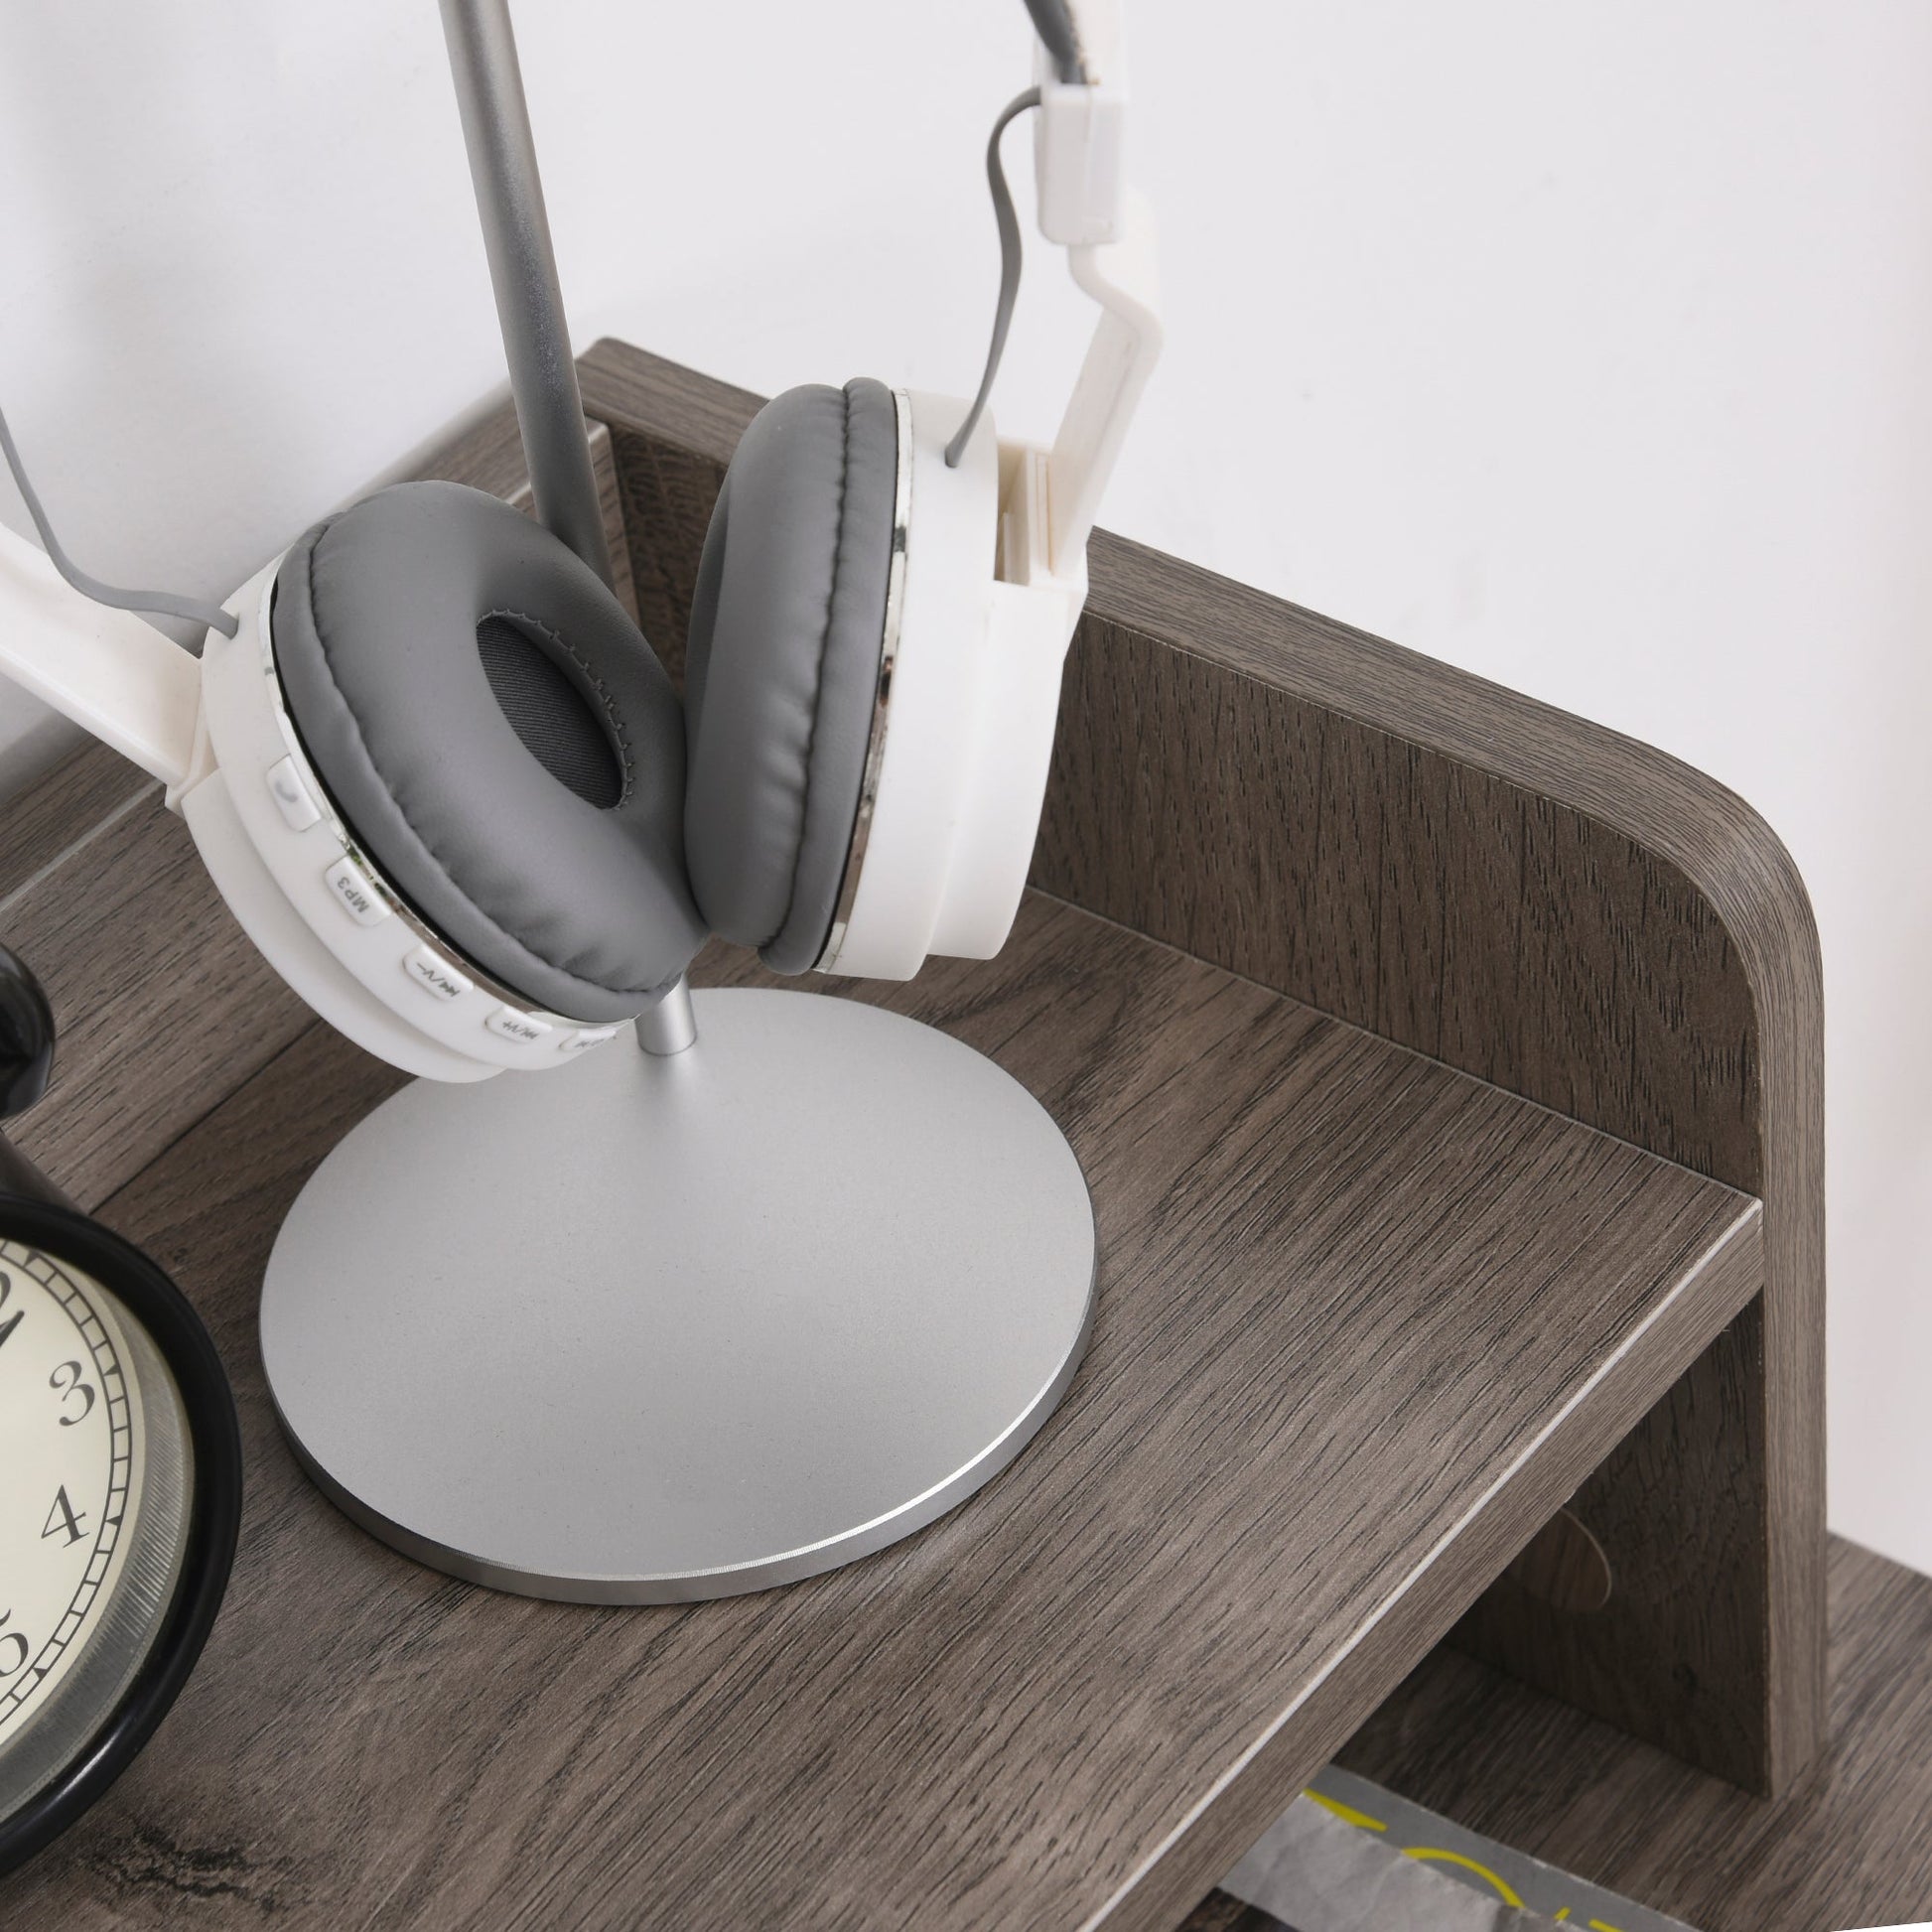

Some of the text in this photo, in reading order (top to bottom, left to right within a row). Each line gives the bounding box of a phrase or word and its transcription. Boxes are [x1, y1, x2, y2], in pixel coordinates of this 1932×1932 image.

[338, 877, 369, 912] MP3
[49, 1360, 95, 1427] 3
[41, 1484, 90, 1549] 4
